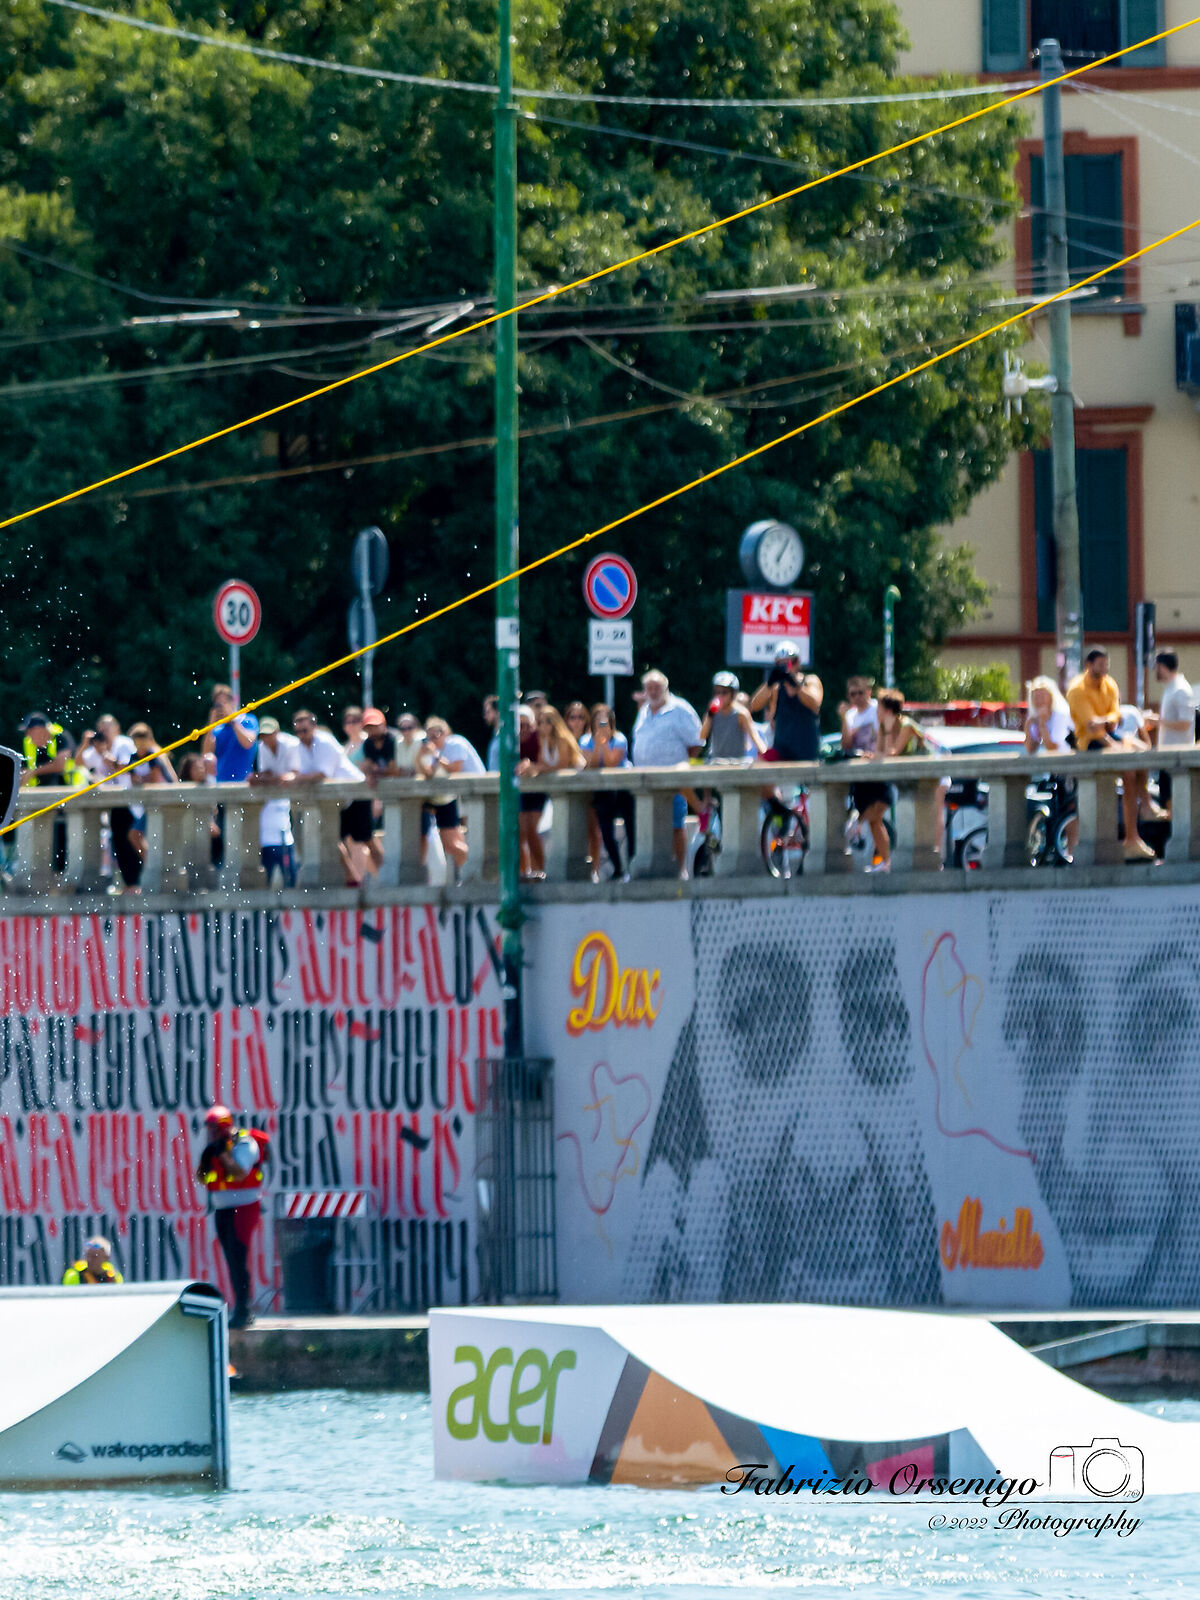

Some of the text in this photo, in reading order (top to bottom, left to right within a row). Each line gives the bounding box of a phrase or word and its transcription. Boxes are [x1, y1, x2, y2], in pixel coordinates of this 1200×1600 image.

[227, 600, 250, 626] 30
[749, 596, 804, 624] KFC
[565, 929, 665, 1038] Dax
[446, 1345, 577, 1446] acer
[91, 1441, 213, 1462] wakeparadise
